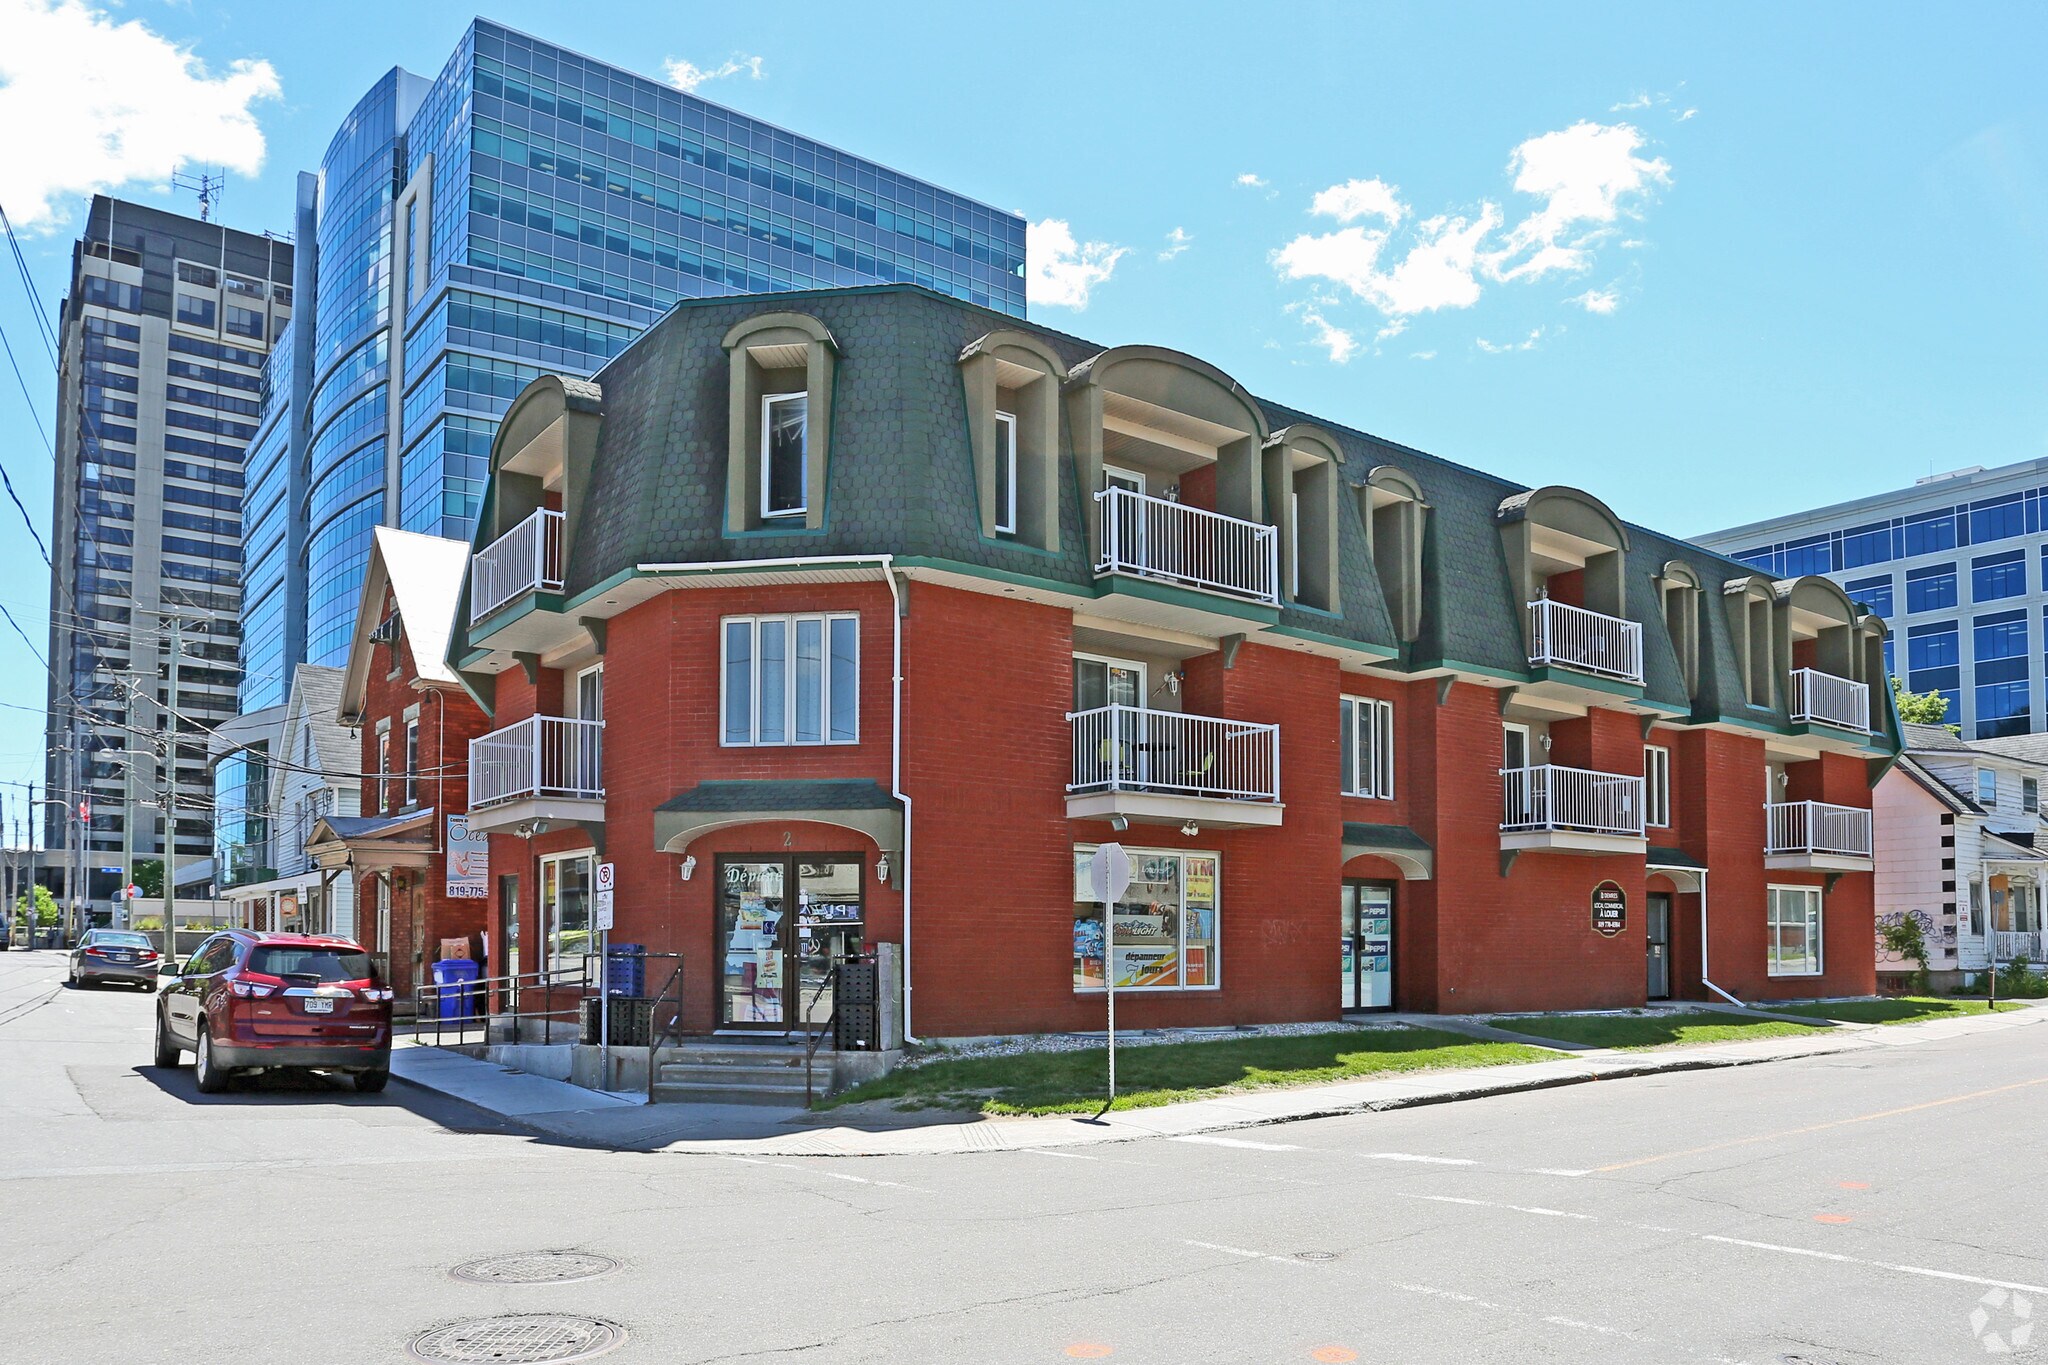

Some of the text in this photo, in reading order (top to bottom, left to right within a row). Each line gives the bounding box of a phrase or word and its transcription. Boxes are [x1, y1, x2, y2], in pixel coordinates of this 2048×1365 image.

[783, 831, 792, 846] 2
[1369, 907, 1386, 915] PEPSI
[1599, 908, 1604, 917] À
[1132, 926, 1158, 937] LIGHT
[1369, 945, 1386, 953] PEPSI
[1125, 951, 1166, 962] dépanneur
[1125, 963, 1164, 985] 7 jours
